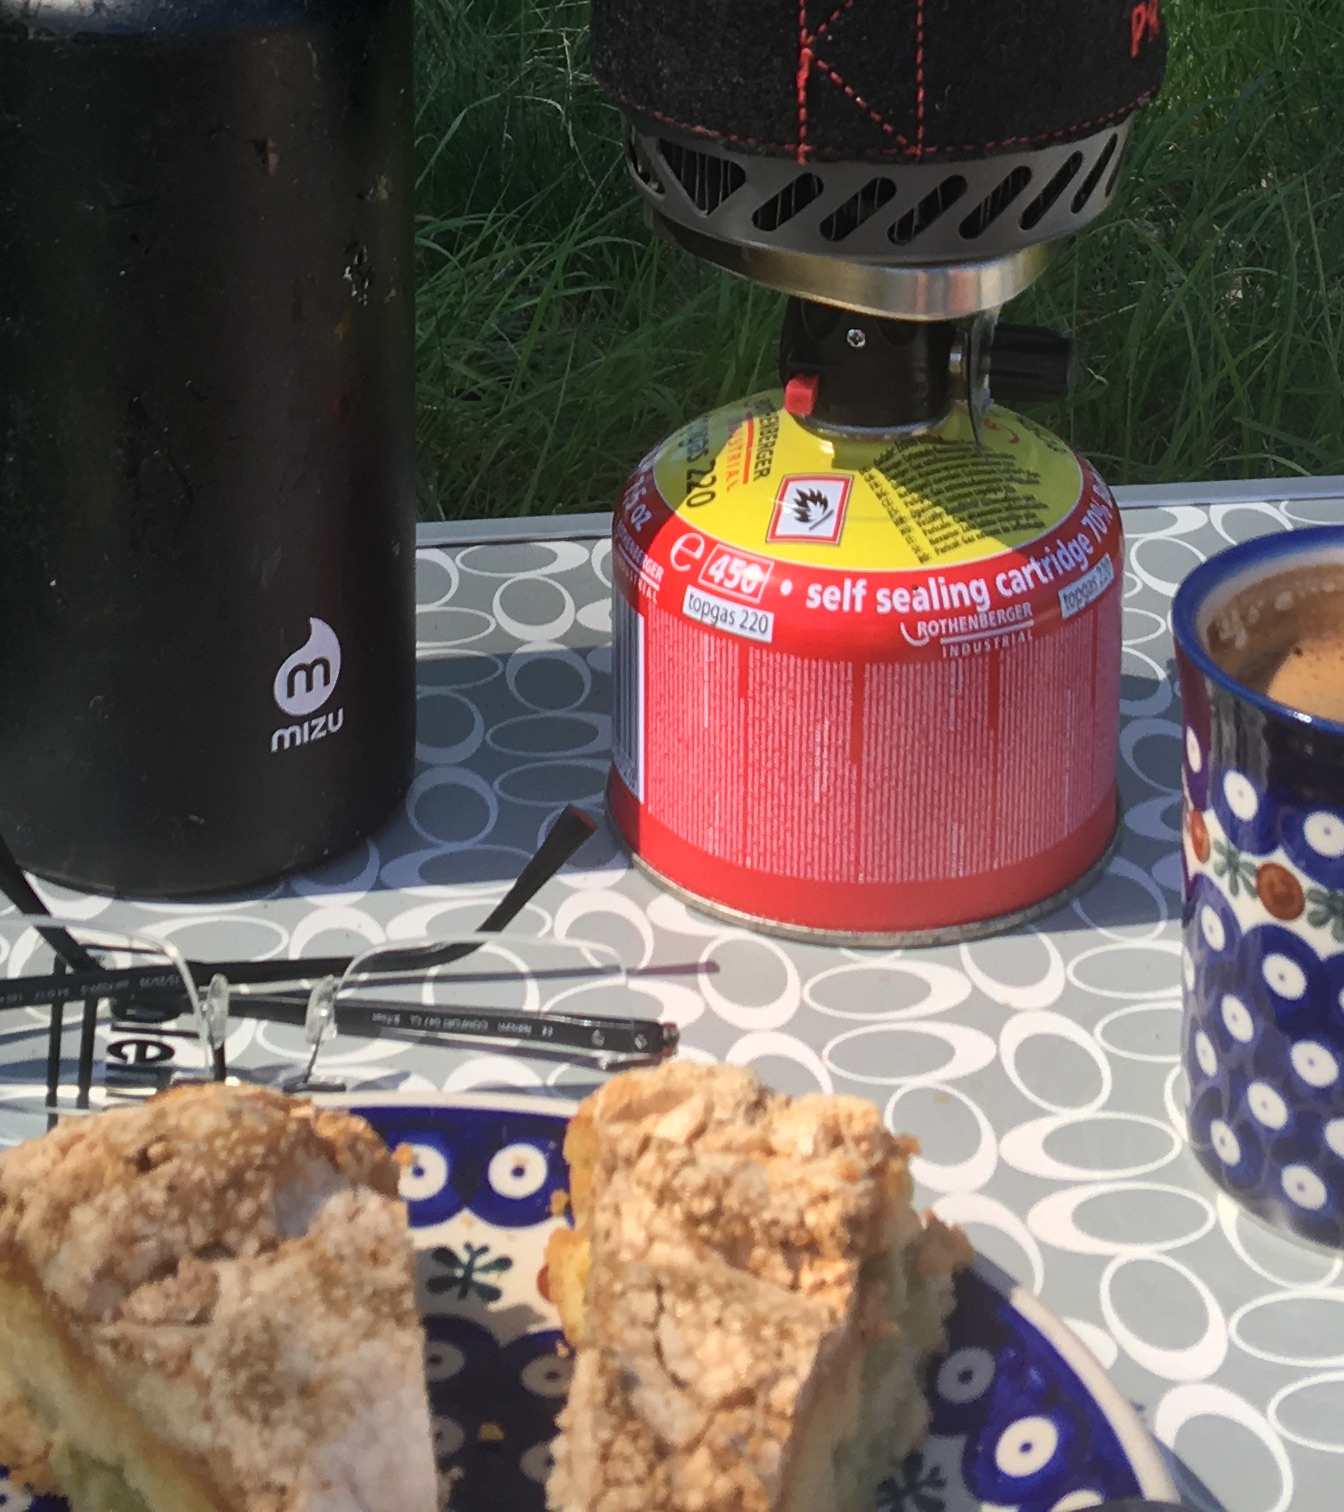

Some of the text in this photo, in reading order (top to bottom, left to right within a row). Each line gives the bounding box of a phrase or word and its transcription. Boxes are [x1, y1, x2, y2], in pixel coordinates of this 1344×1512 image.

[806, 578, 868, 614] self
[876, 576, 991, 614] sealing
[996, 532, 1094, 598] cartridge
[687, 591, 770, 635] topgas 220
[916, 601, 1034, 638] ROTHENBERGER
[942, 628, 1034, 659] INDUSTRIAL
